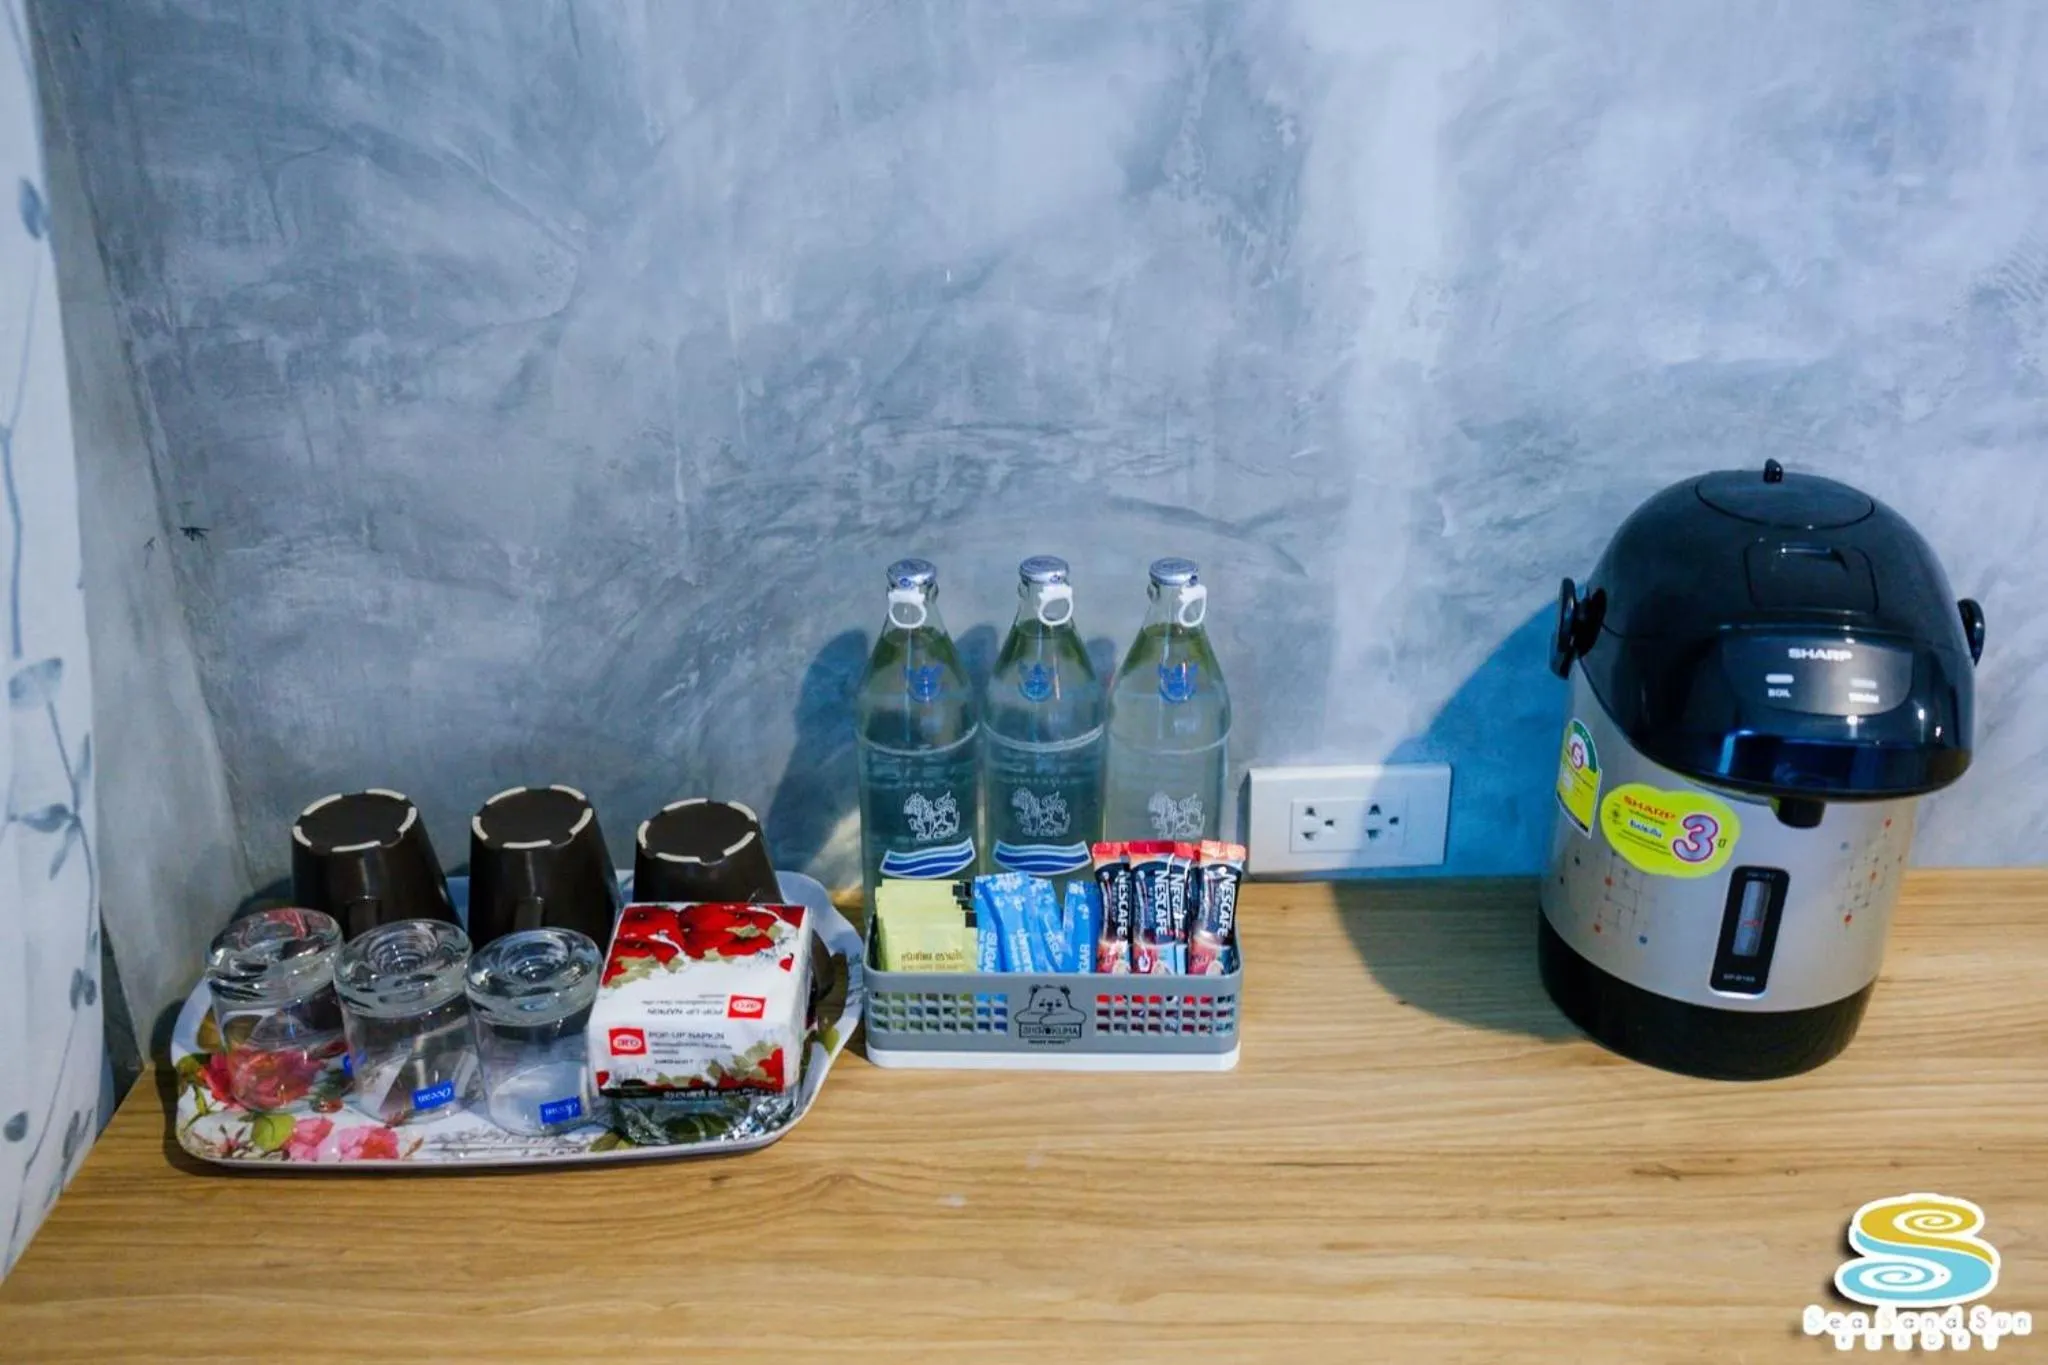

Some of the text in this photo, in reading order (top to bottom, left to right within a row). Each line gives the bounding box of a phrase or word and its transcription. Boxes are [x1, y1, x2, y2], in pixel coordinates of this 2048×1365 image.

[1788, 648, 1853, 661] SHARP
[1768, 688, 1791, 698] BOIL
[1623, 795, 1676, 820] SHARP
[1672, 813, 1719, 863] 3
